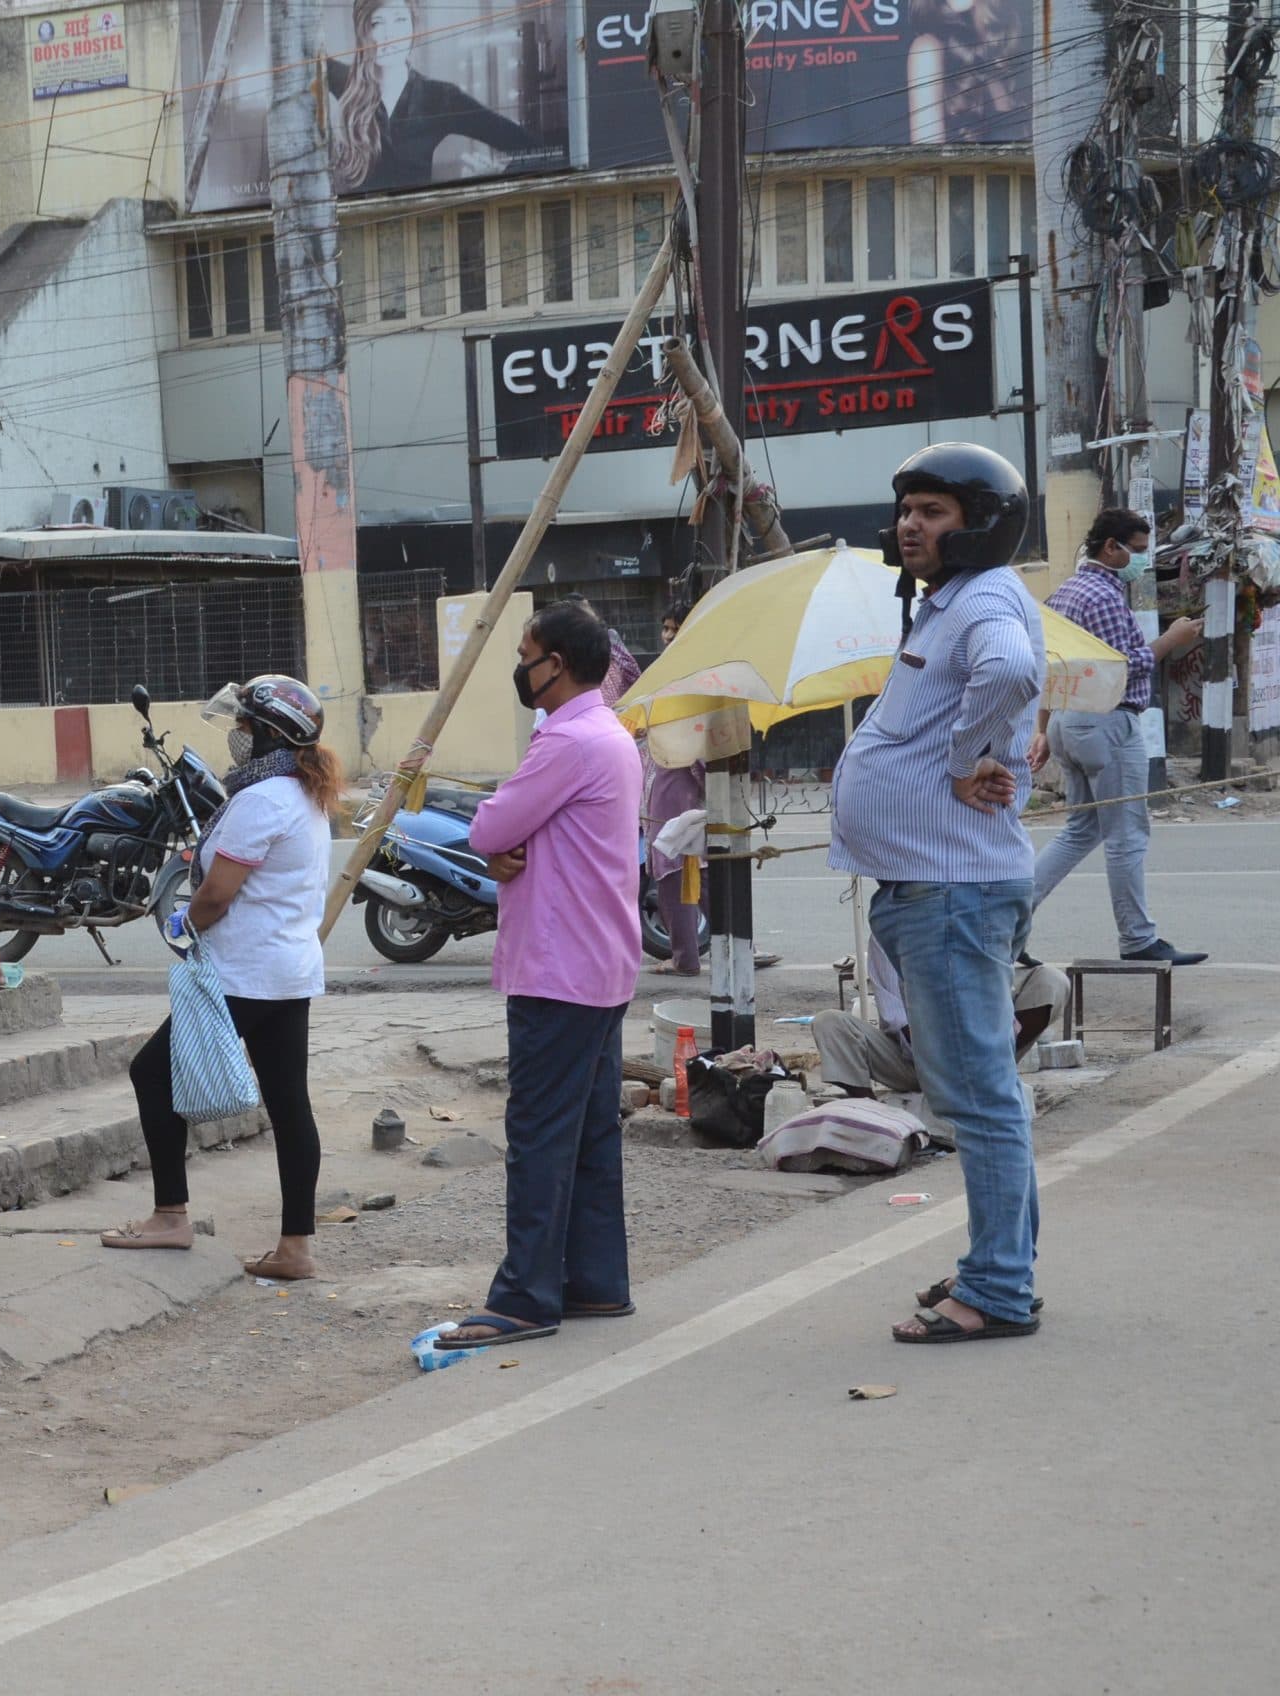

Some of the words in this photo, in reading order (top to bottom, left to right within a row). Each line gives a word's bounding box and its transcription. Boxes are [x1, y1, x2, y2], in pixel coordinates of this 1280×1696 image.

[33, 41, 70, 64] BOYS
[73, 31, 125, 57] HOSTEL
[803, 45, 857, 66] Salon
[818, 387, 917, 417] Salon
